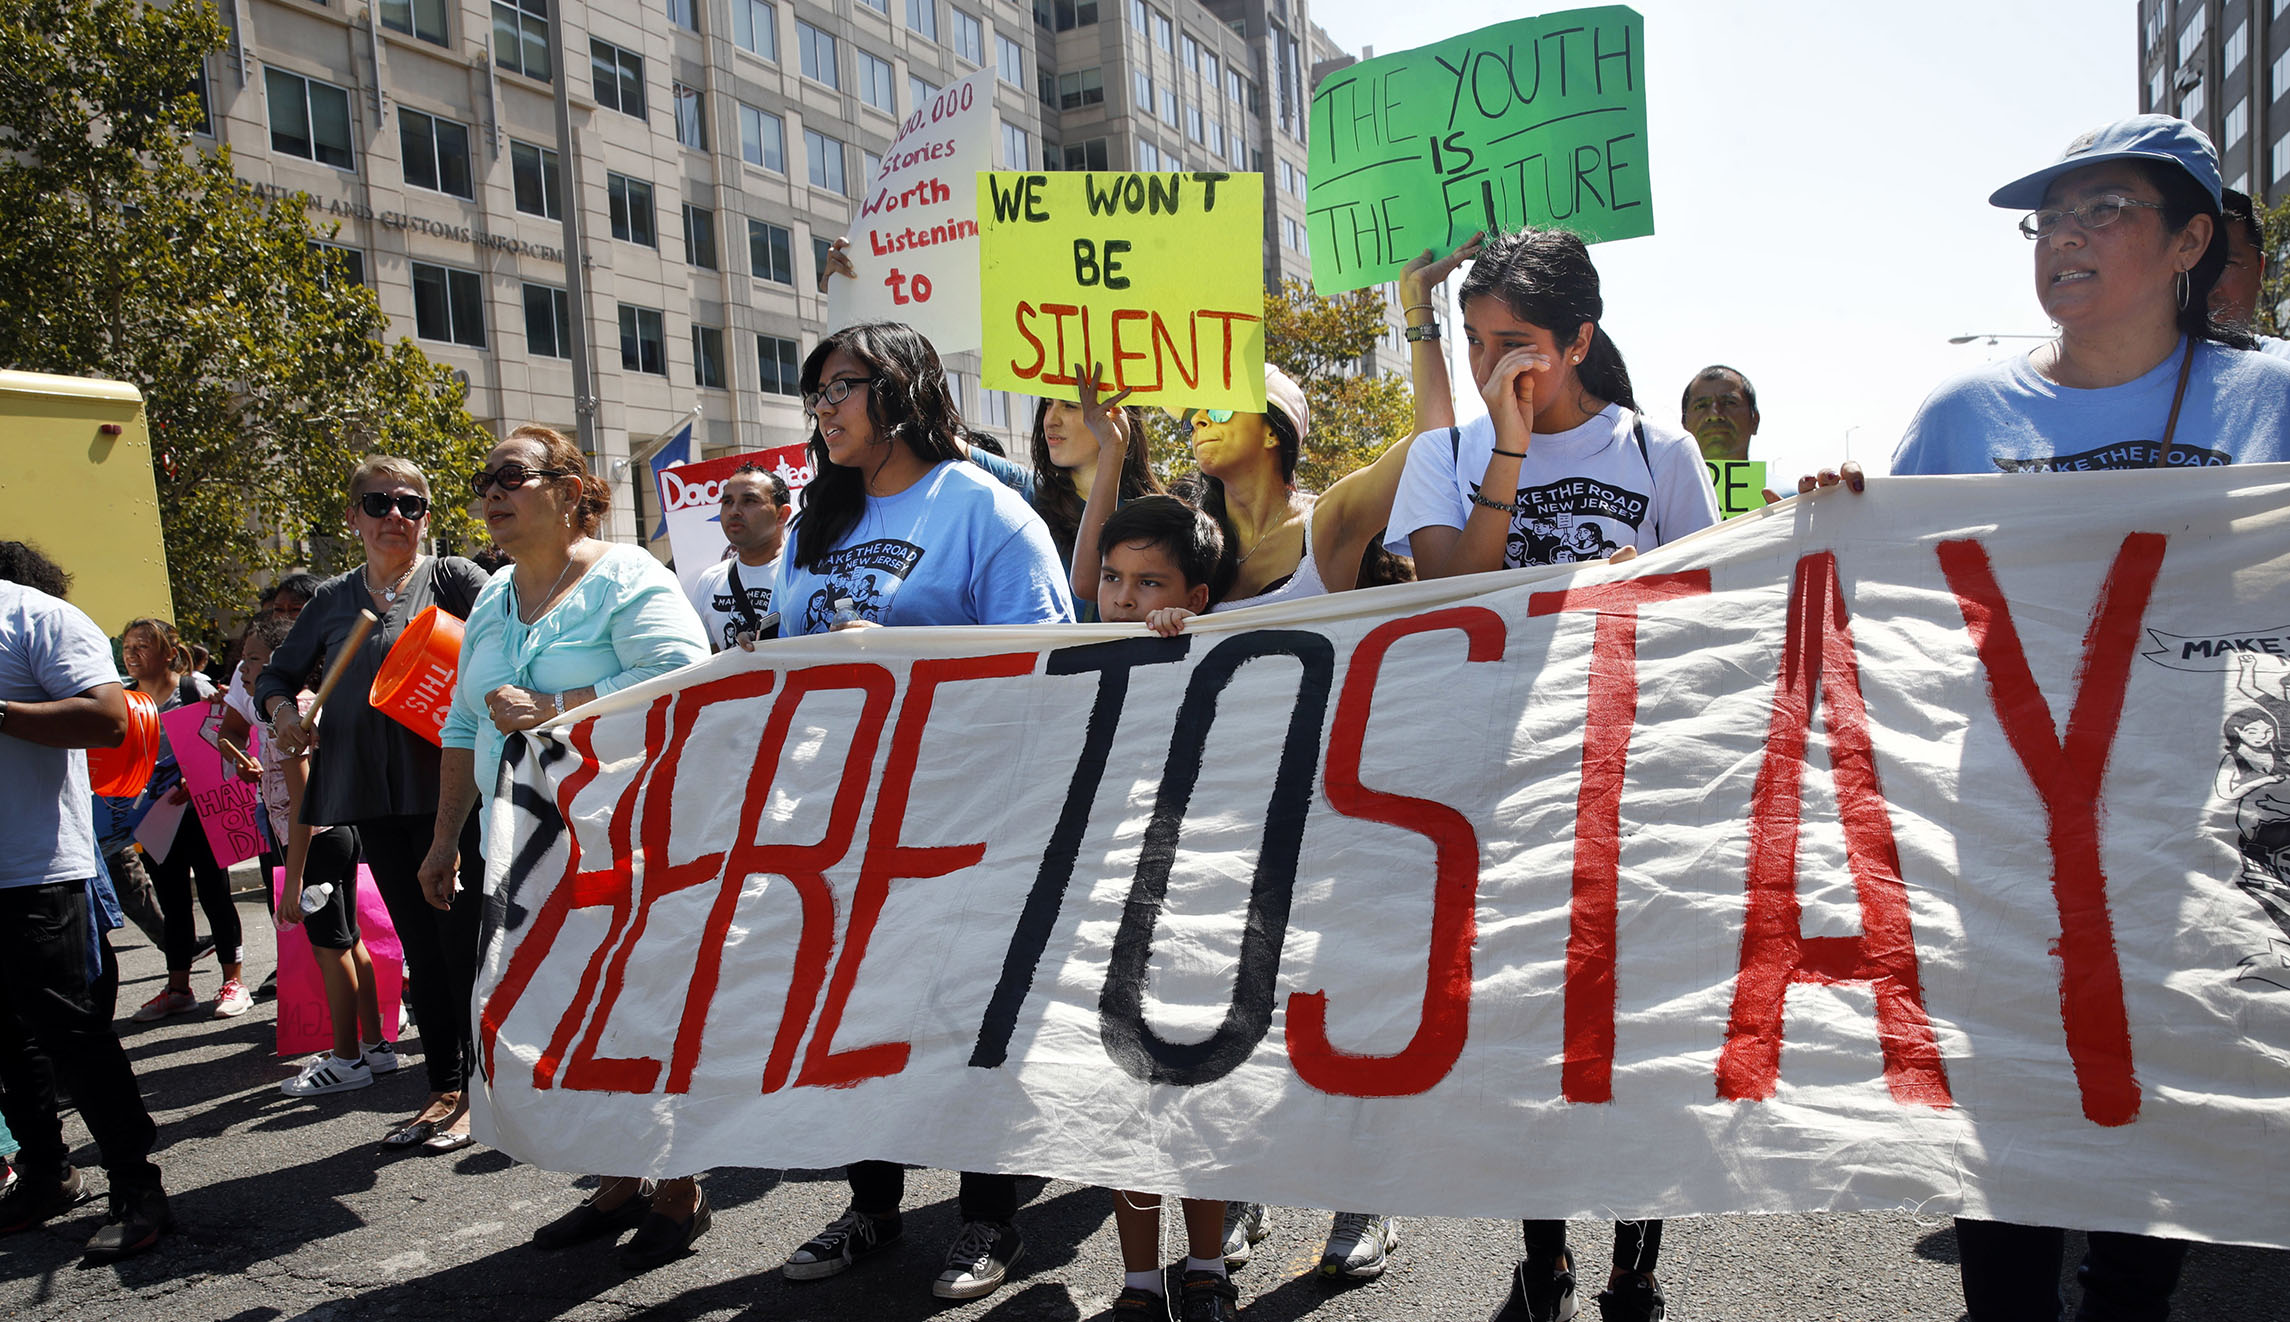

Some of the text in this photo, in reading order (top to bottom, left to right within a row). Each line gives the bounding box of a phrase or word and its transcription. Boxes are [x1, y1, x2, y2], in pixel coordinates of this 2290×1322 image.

[1313, 25, 1633, 164] THE YOUTH
[1429, 131, 1475, 175] IS
[861, 177, 951, 219] Worth
[989, 171, 1231, 224] WE WON'T
[1306, 133, 1641, 275] THE FUTURE
[329, 200, 374, 221] AND
[380, 210, 470, 243] CUSTOMS
[869, 218, 980, 257] Listenin
[1073, 238, 1132, 290] BE
[884, 267, 933, 306] to
[1010, 301, 1263, 392] SILENT
[2093, 446, 2144, 465] THE
[1537, 497, 1639, 520] NEW JERSEY
[1546, 482, 1585, 501] THE
[1588, 483, 1642, 513] ROAD
[845, 555, 910, 572] NEW JERSEY
[856, 543, 882, 557] THE
[881, 543, 918, 562] ROAD
[2181, 637, 2286, 660] MAKE
[480, 651, 1040, 1095] HERE
[967, 629, 1336, 1087] TO
[1284, 531, 2168, 1128] STAY
